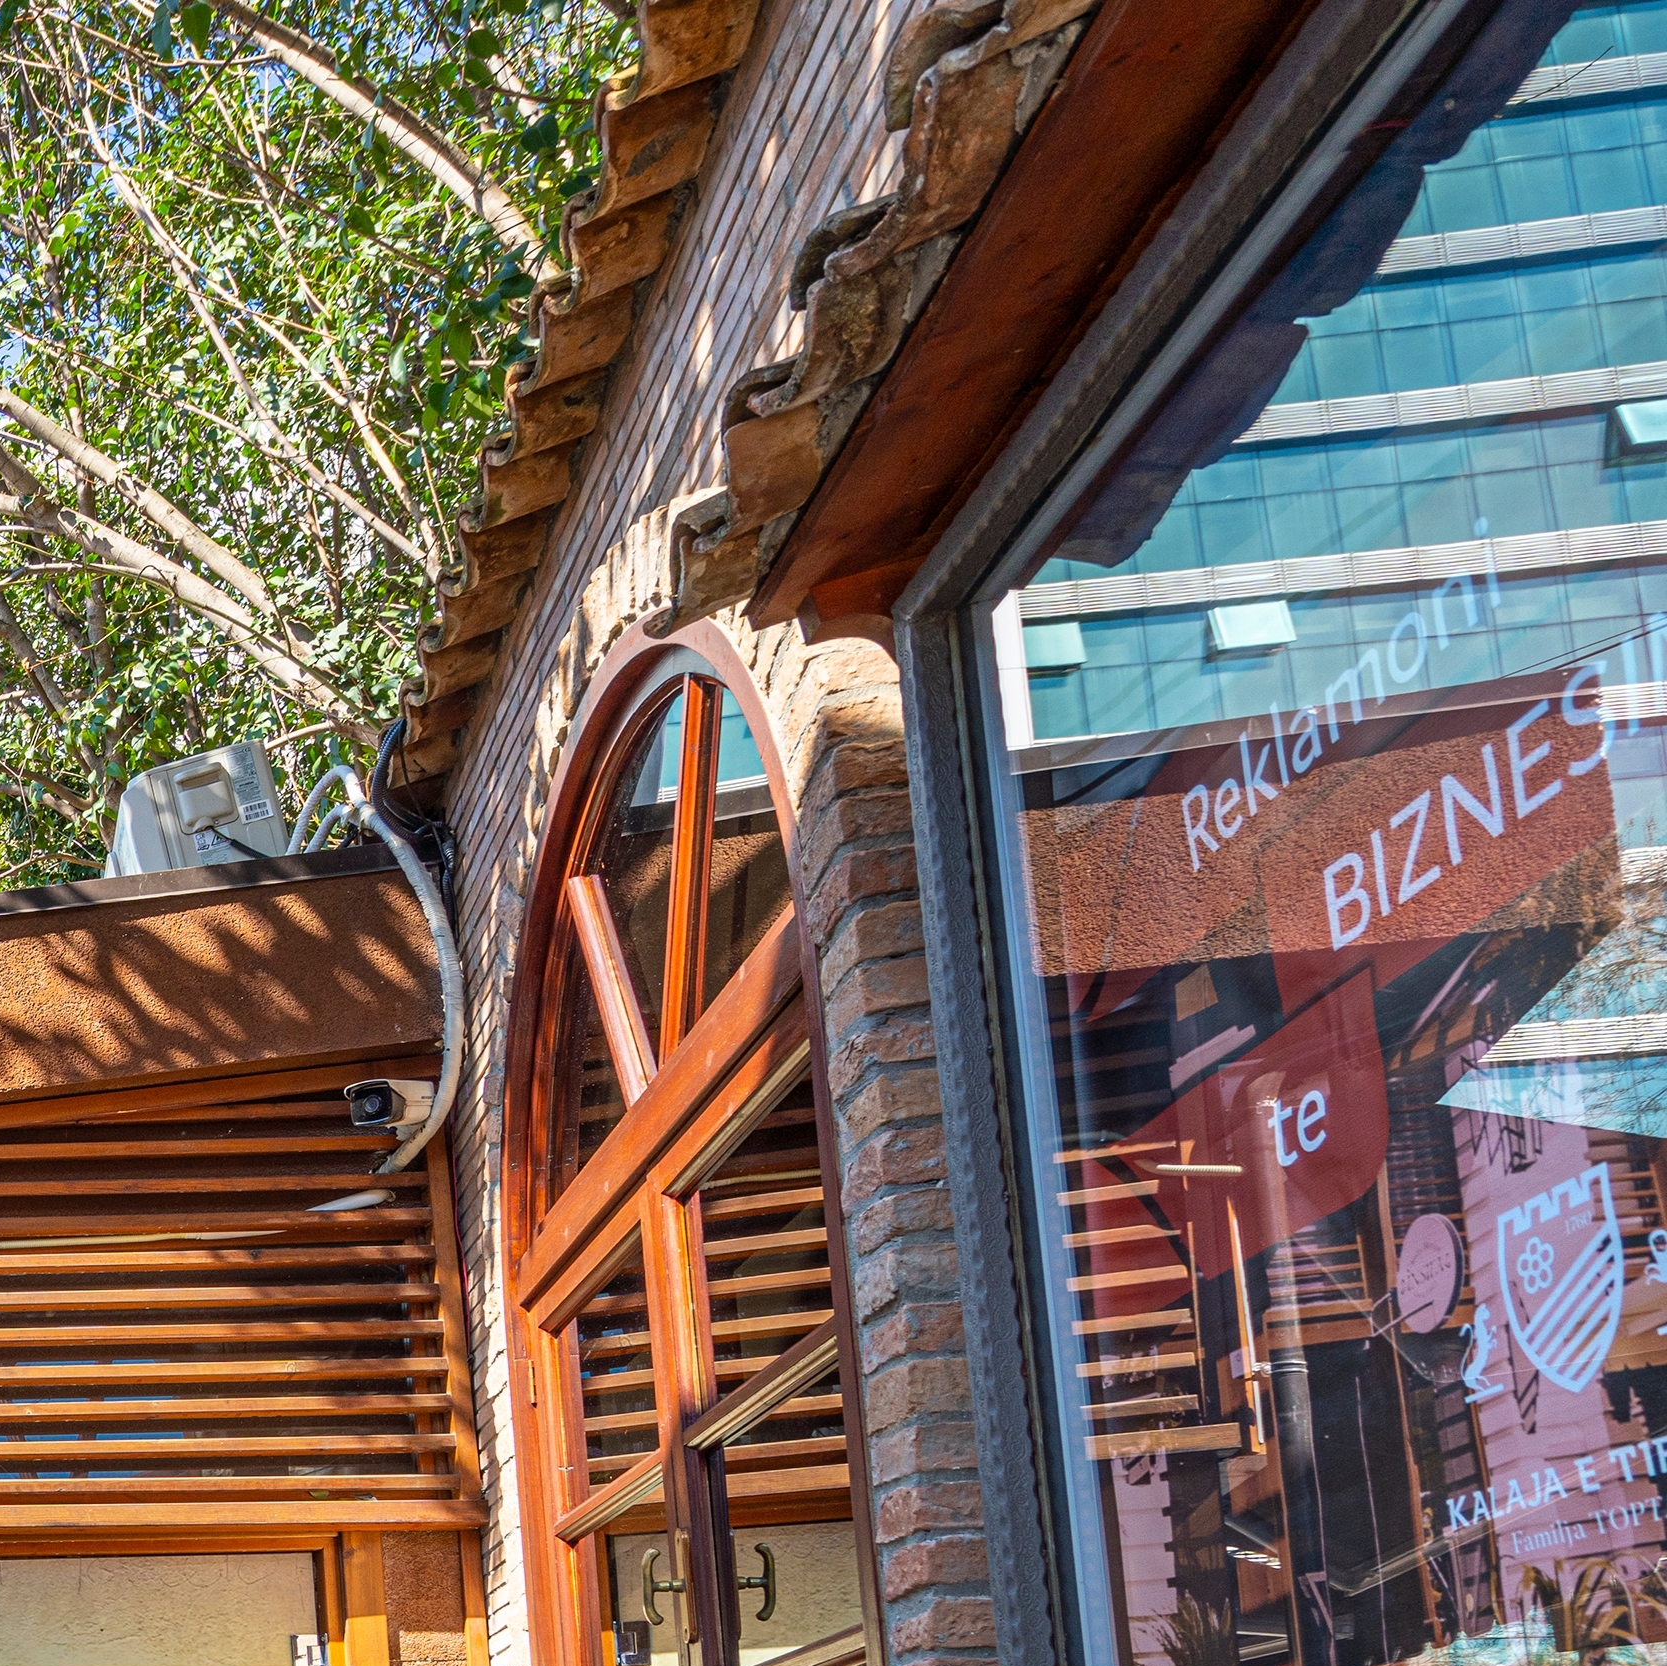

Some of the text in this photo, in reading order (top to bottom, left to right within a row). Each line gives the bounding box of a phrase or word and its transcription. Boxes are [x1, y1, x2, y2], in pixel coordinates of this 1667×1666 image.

[1182, 517, 1501, 872] Reklamoni
[1268, 1090, 1327, 1167] te
[1446, 1467, 1568, 1531] KALAJA
[1574, 1456, 1602, 1493] E
[1511, 1495, 1667, 1554] Familja TOPT
